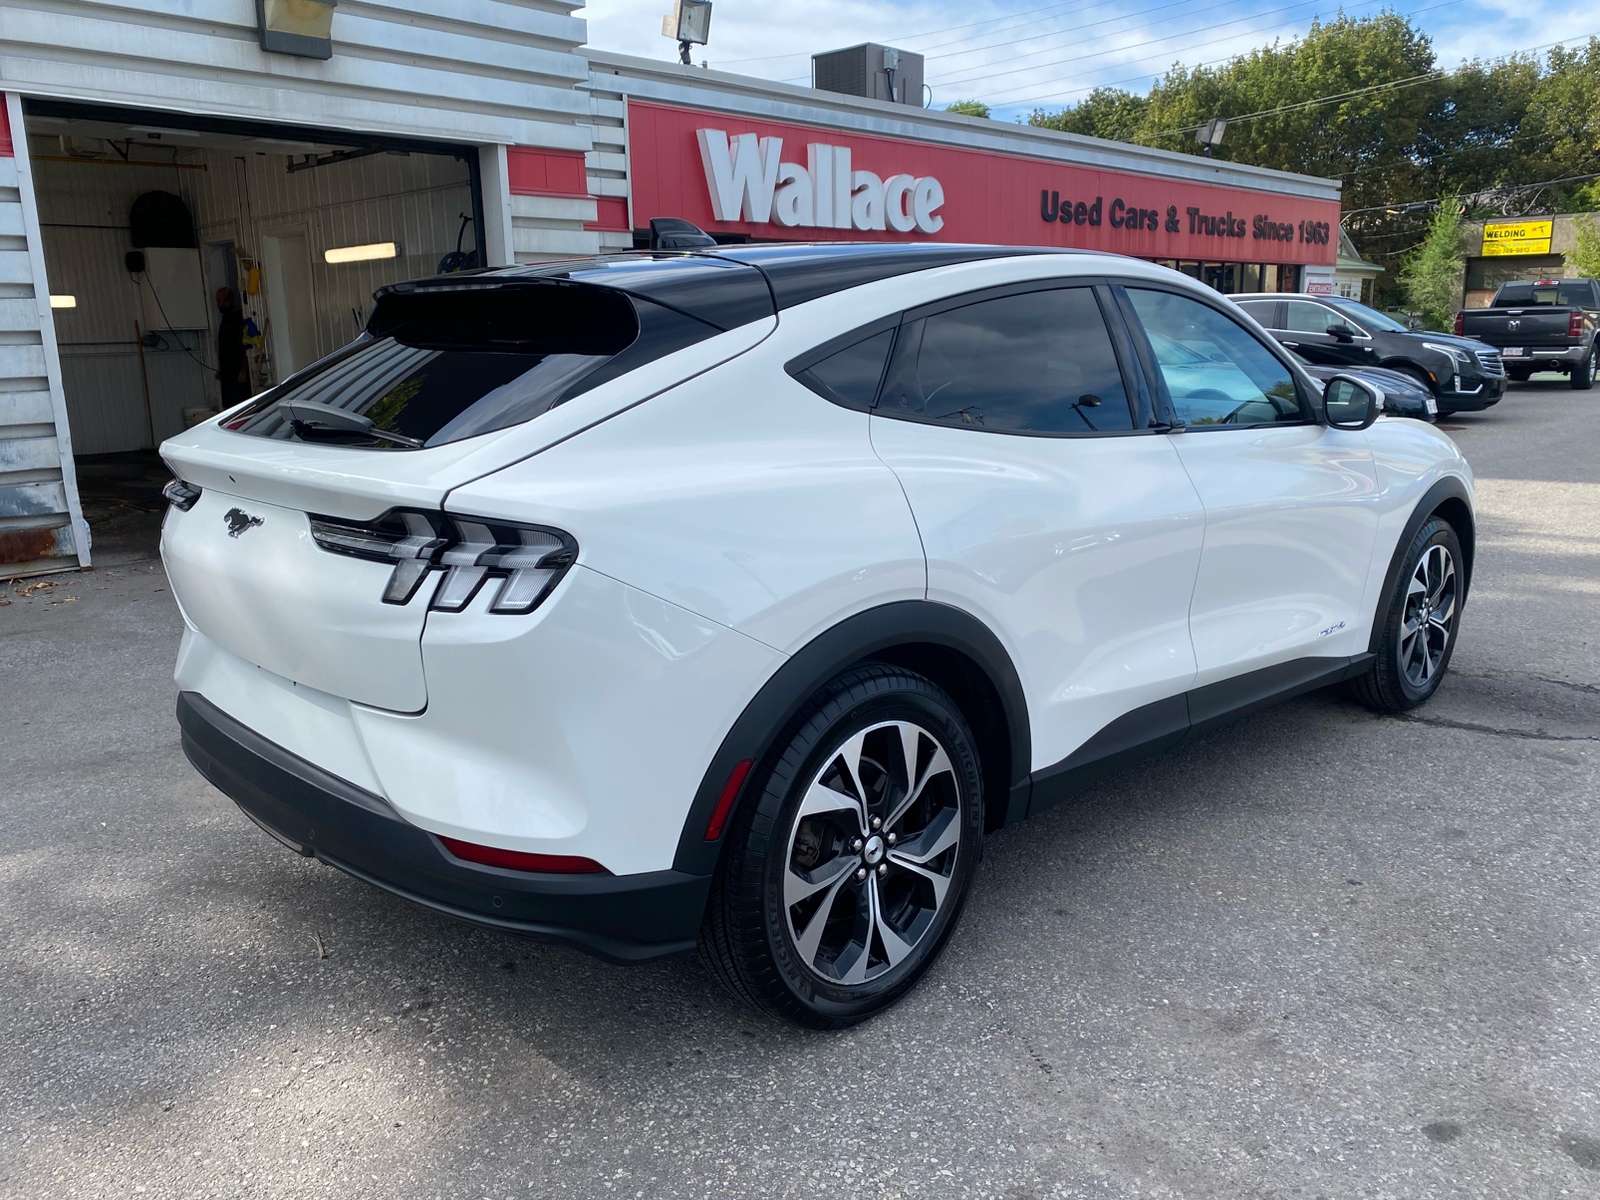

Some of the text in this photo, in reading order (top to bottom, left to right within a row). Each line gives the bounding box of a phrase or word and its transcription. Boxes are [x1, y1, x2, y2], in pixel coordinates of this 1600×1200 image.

[696, 128, 944, 233] Wallace
[1041, 190, 1330, 244] Used Cars & Trucks Since 1963
[1486, 230, 1525, 238] WELDING
[956, 741, 979, 822] MICHELIN
[768, 891, 798, 982] MICHELIN
